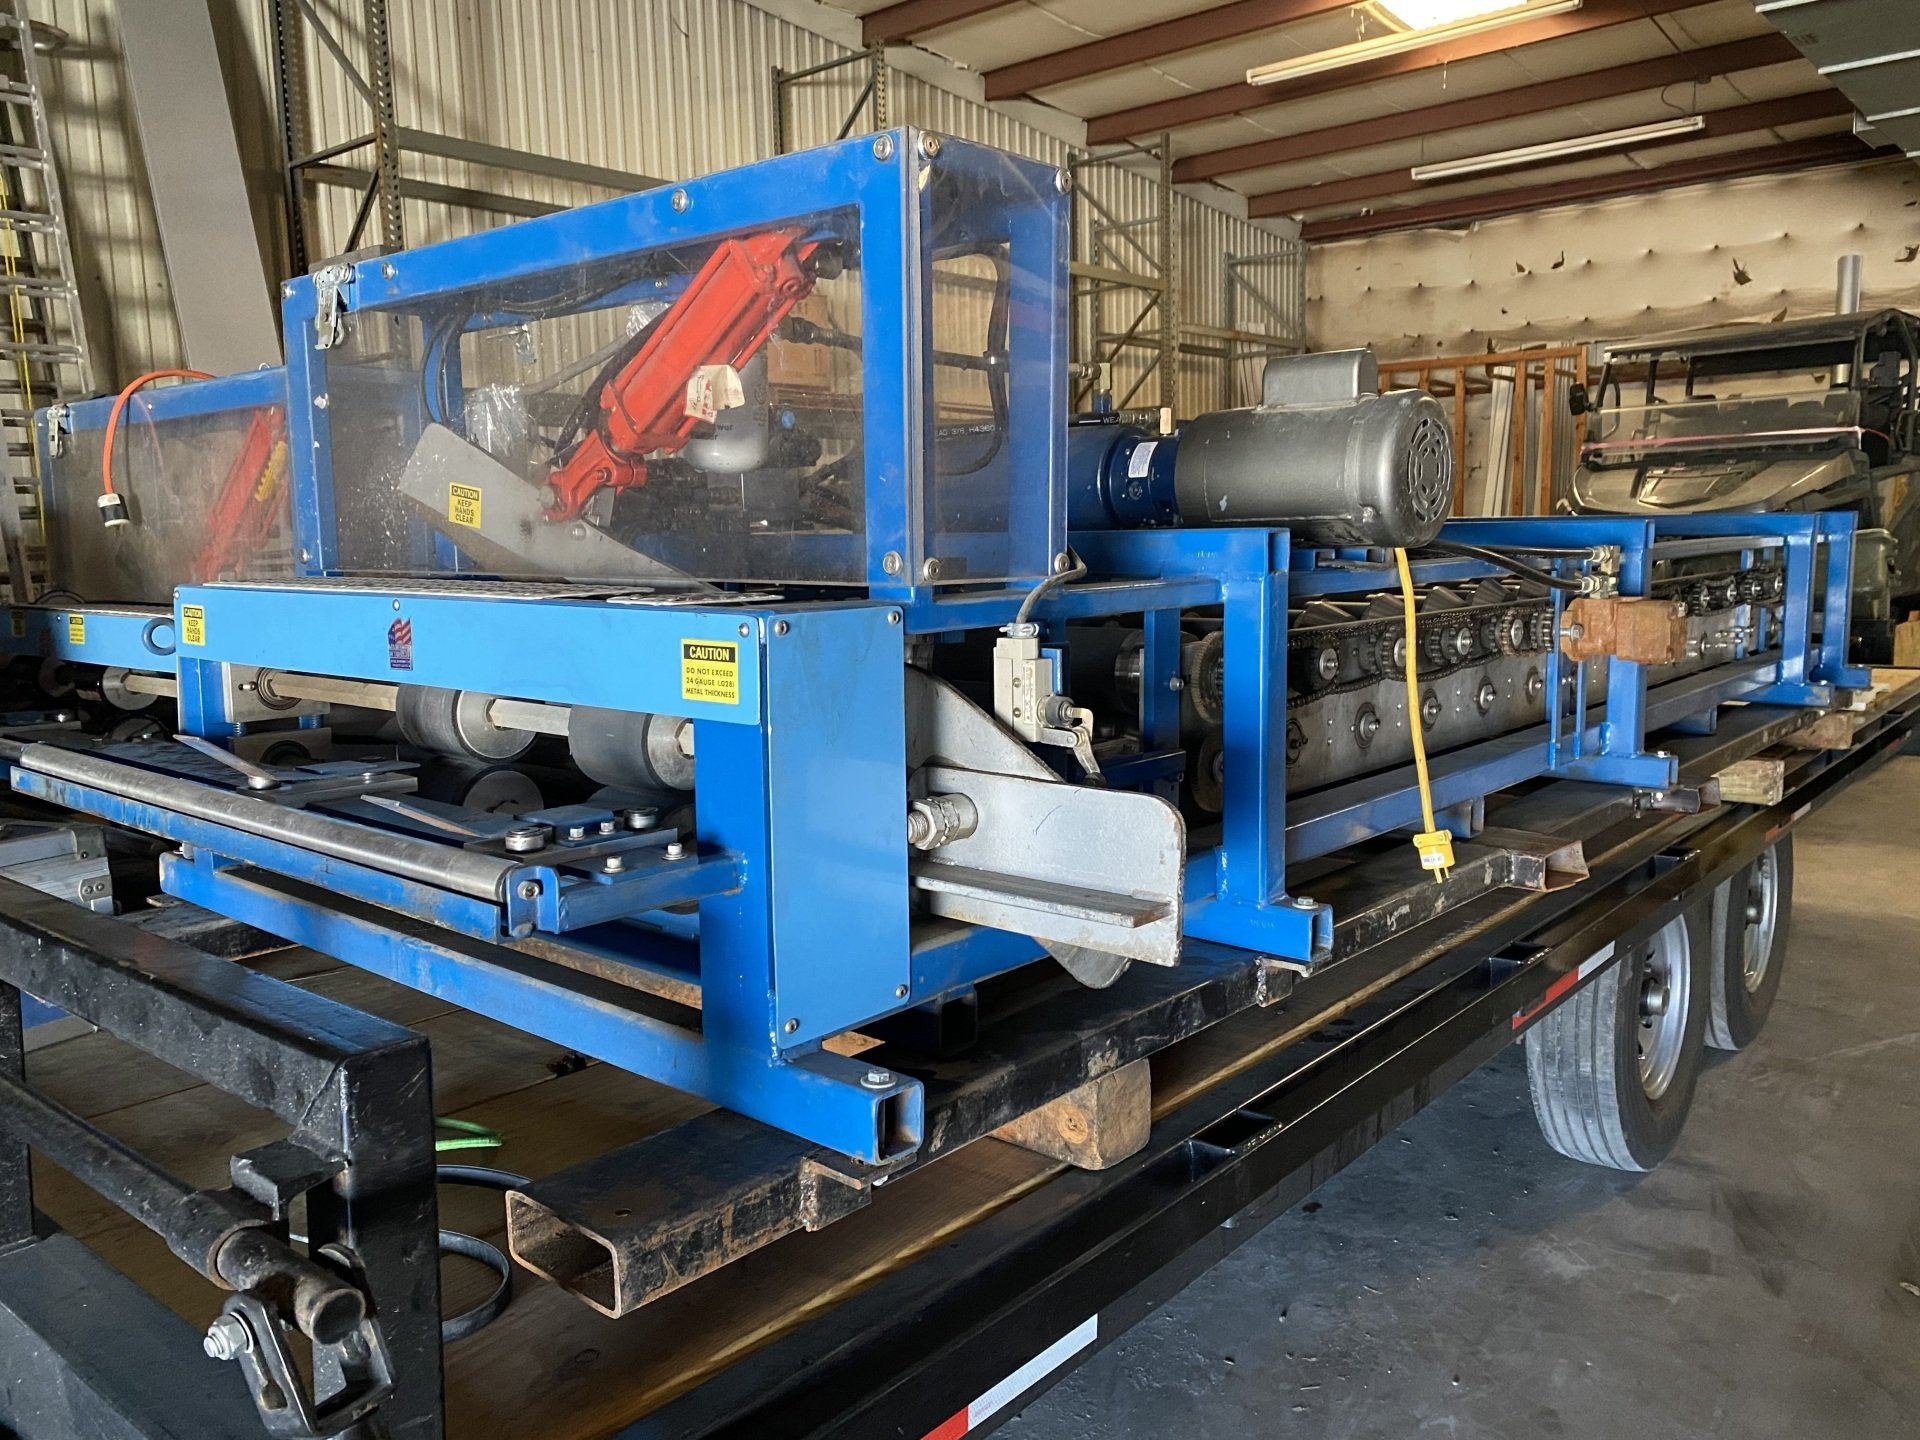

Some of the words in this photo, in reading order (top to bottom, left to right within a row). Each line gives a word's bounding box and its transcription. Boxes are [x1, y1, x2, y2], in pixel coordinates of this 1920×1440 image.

[452, 487, 478, 499] CAUTION
[458, 499, 472, 507] KEEP
[455, 506, 474, 516] HANDS
[456, 514, 473, 524] CLEAR
[689, 646, 730, 661] CAUTION
[697, 668, 710, 676] NOT
[712, 669, 733, 677] EXCEED
[686, 676, 694, 684] 24
[685, 687, 703, 695] METAL
[705, 689, 735, 698] THICKNESS
